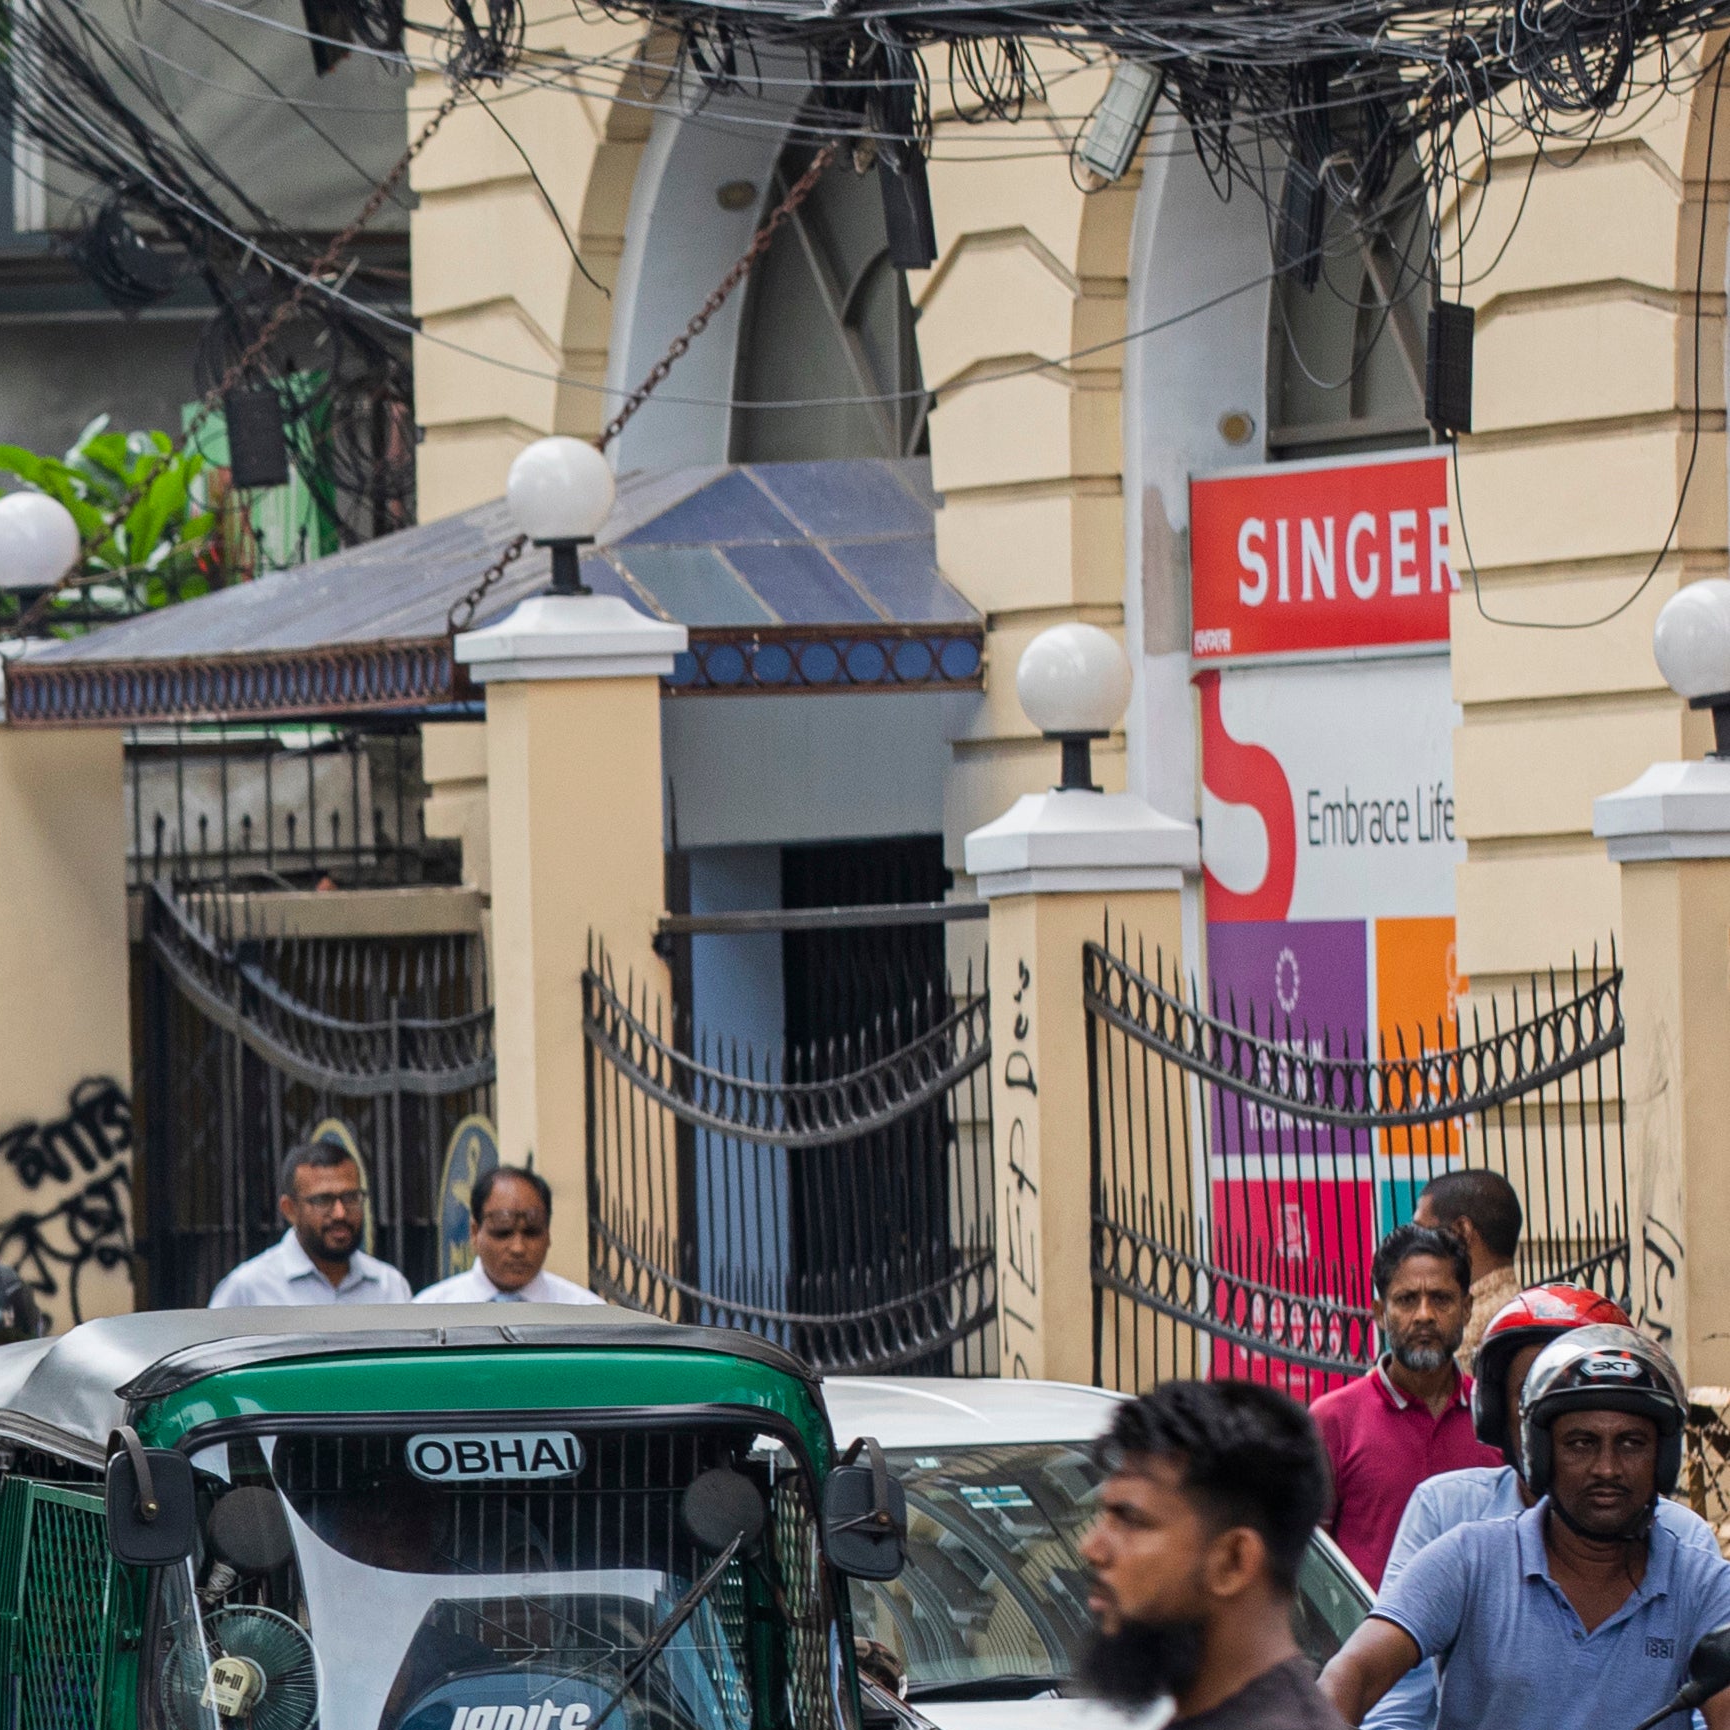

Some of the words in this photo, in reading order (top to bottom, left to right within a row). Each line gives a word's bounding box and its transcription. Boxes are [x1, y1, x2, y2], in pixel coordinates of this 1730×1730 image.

[1237, 505, 1460, 607] SINGER
[1306, 785, 1410, 846] Embrace
[1416, 781, 1454, 844] Life
[414, 1437, 579, 1476] OBHAI
[1645, 1643, 1674, 1659] 1881
